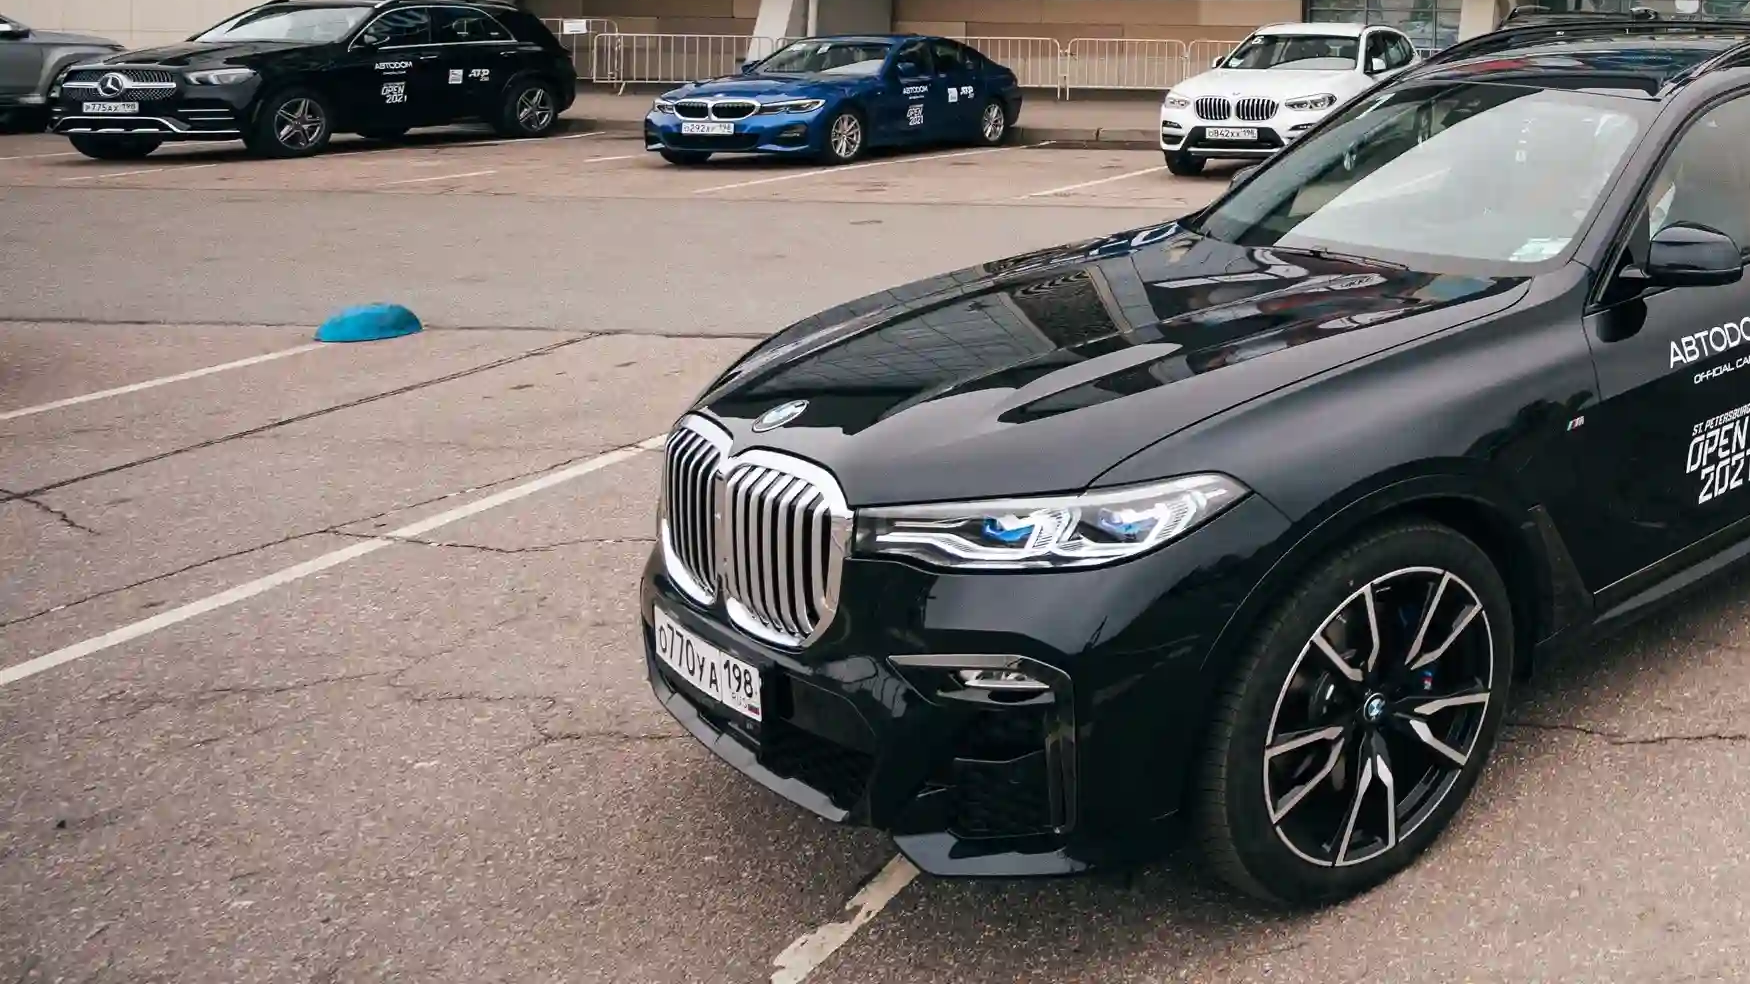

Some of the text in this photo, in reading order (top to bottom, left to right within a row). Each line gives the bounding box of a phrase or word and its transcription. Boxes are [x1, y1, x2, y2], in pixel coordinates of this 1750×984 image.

[385, 94, 408, 104] 2021
[1693, 362, 1735, 384] OFFICIAL
[1685, 416, 1750, 474] OPEN
[723, 659, 754, 698] 198
